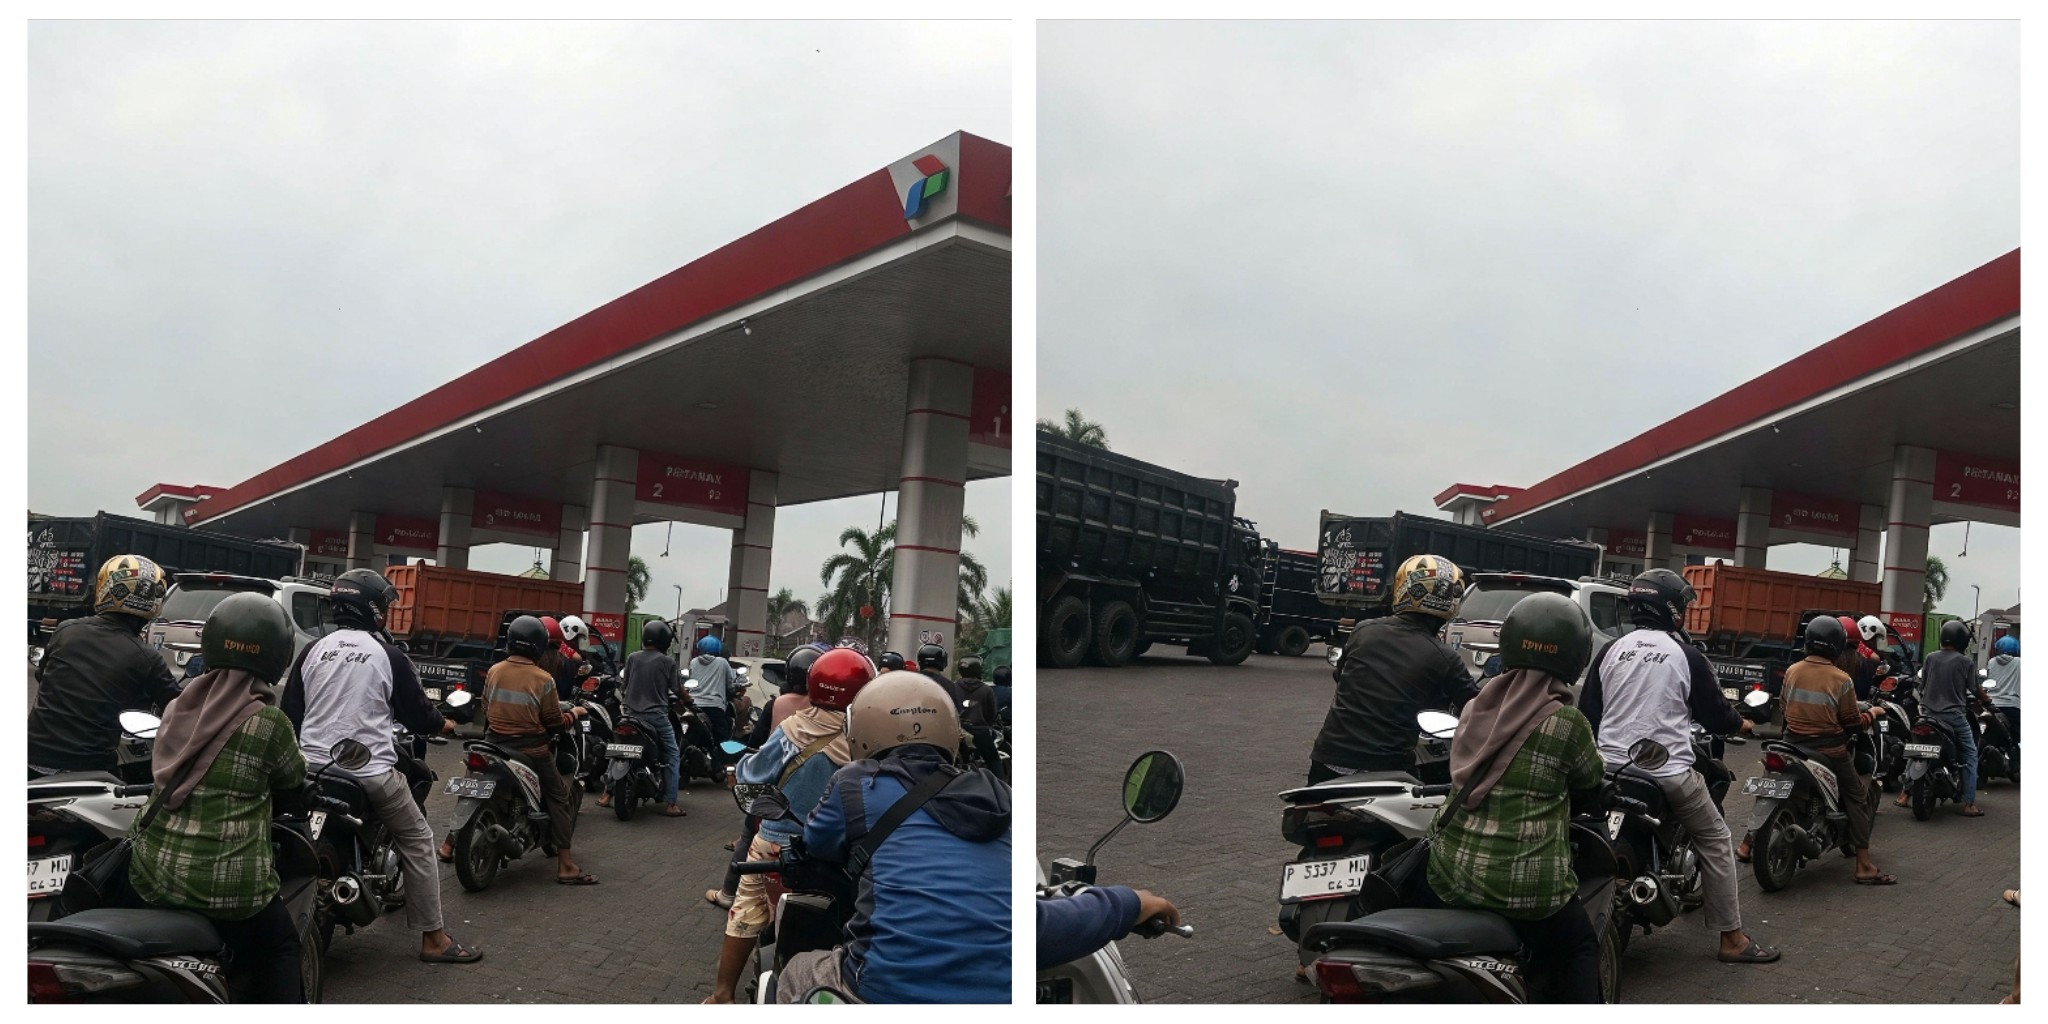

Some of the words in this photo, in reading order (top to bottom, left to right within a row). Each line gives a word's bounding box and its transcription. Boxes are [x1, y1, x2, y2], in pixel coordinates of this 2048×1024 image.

[652, 483, 664, 498] 2
[1950, 483, 1962, 498] 2
[1286, 867, 1295, 882] P
